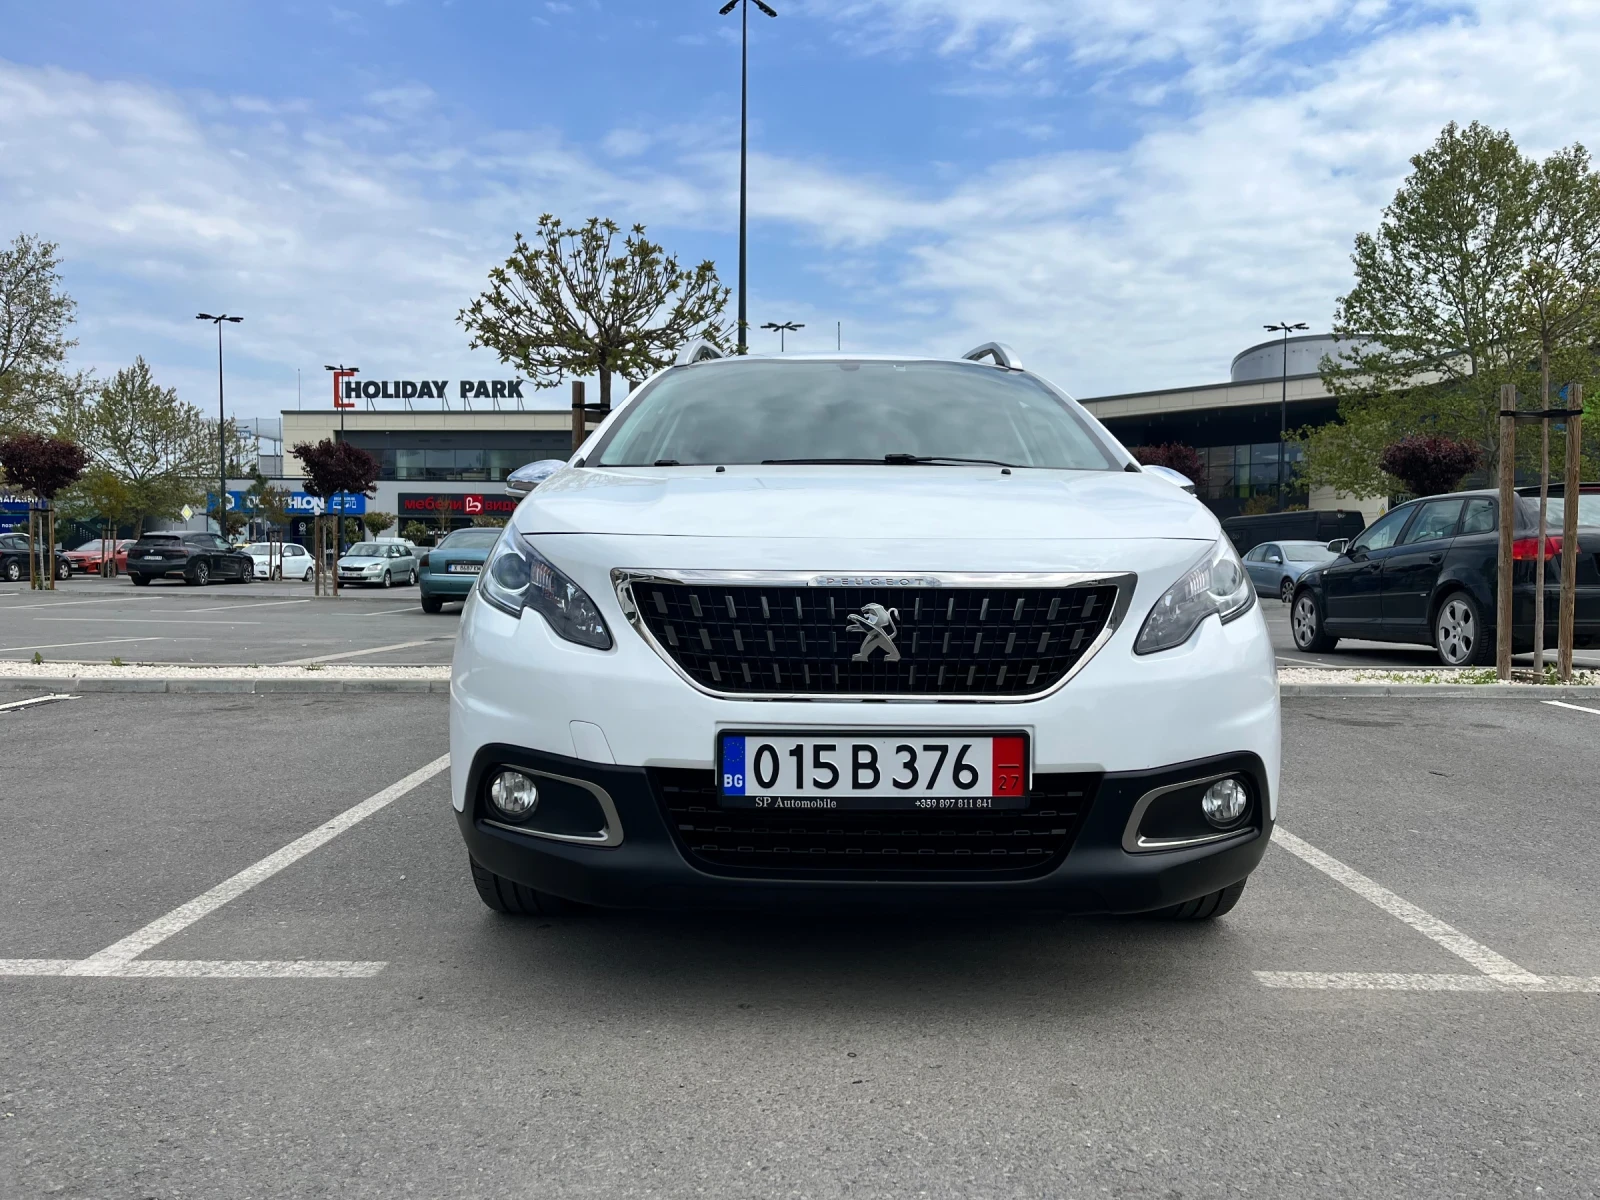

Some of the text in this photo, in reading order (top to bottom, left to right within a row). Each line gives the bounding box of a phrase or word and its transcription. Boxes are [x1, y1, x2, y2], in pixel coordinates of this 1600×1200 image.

[345, 380, 524, 398] HOLIDAY PARK
[404, 496, 462, 510] мебели
[826, 578, 924, 586] PEUGEOT
[723, 774, 743, 788] BG
[998, 774, 1020, 791] 27
[755, 796, 837, 809] SP Automobile
[914, 799, 992, 809] +359 897 811 841
